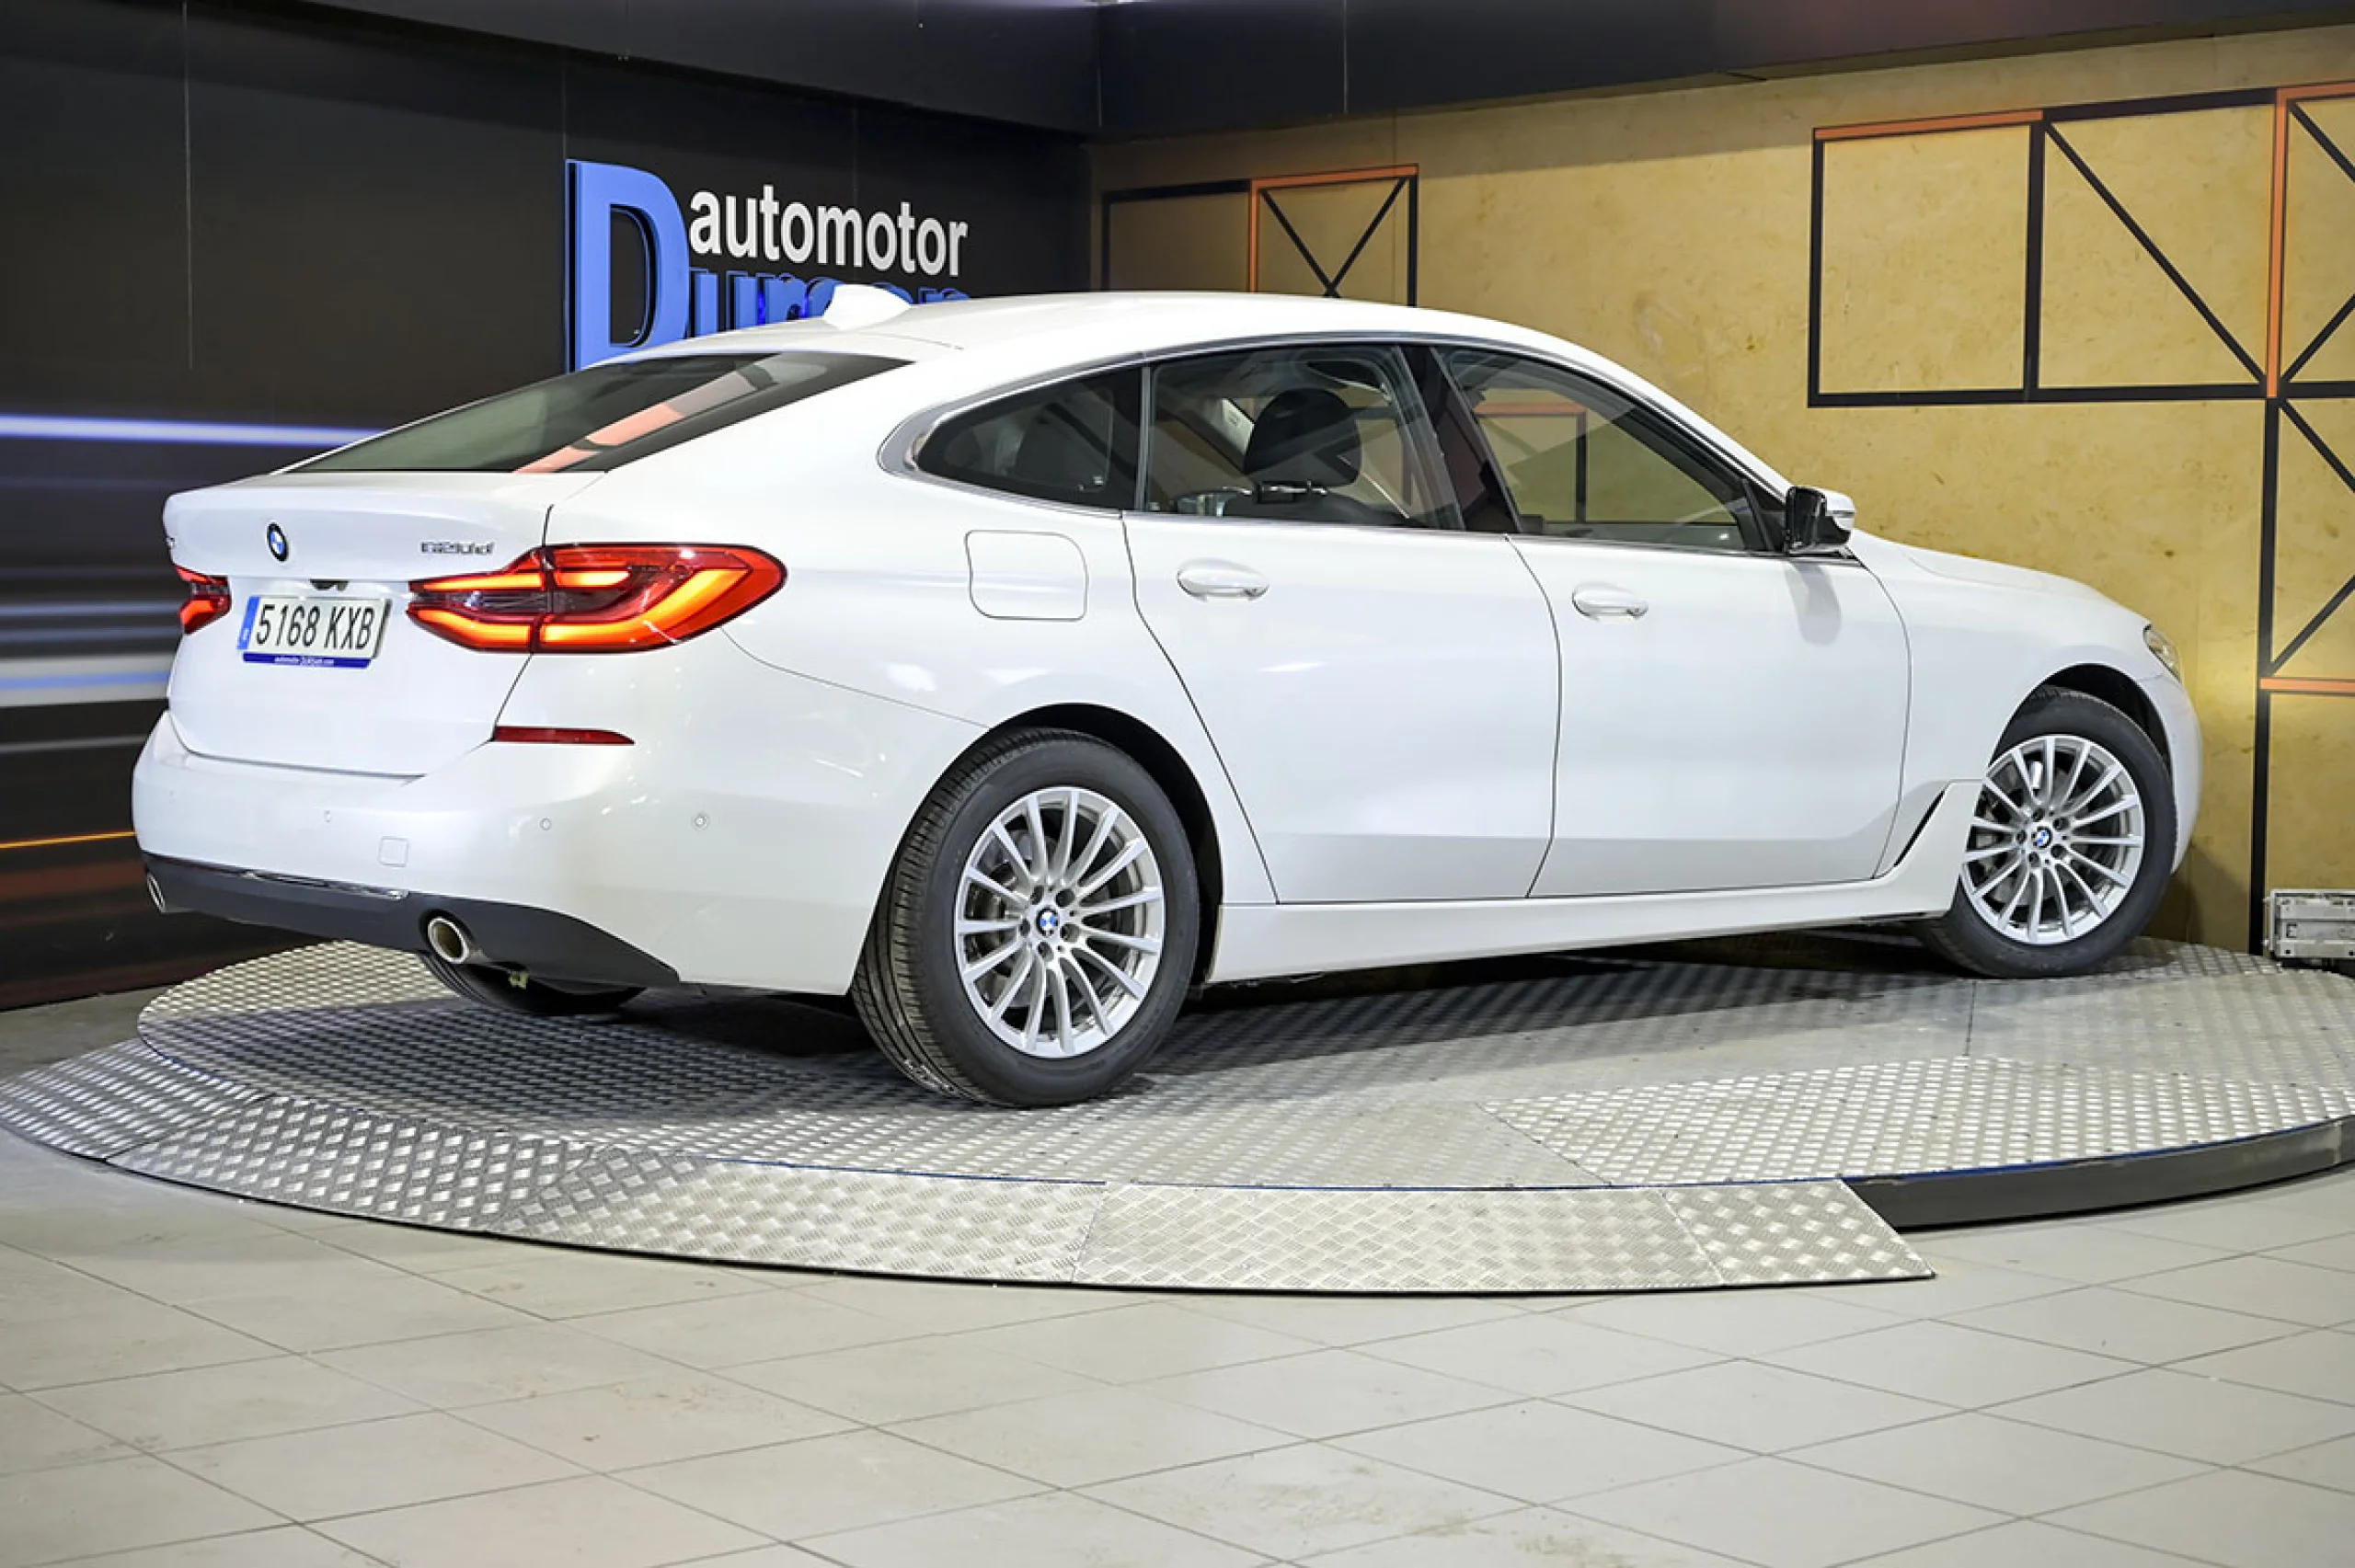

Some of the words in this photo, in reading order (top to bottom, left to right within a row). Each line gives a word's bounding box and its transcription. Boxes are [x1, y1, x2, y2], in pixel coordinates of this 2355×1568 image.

[689, 184, 969, 278] automotor
[256, 603, 321, 647] 5168
[323, 605, 375, 650] KXB
